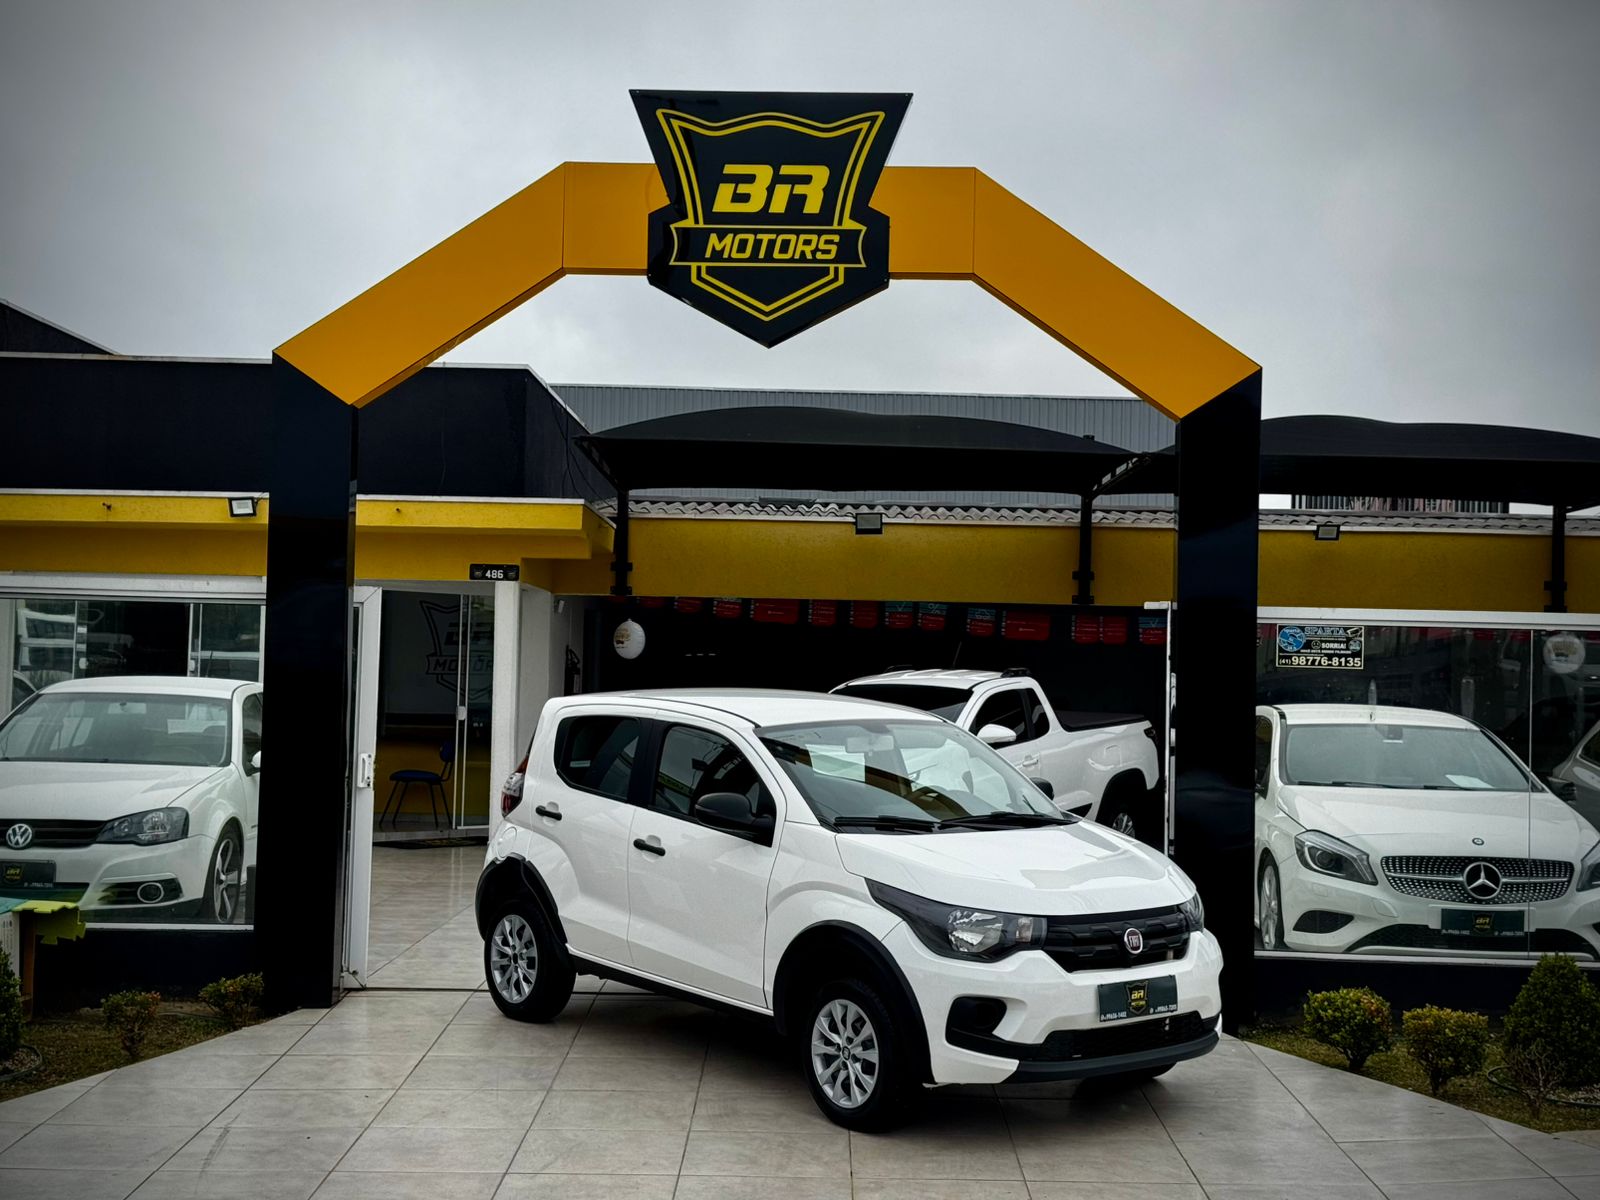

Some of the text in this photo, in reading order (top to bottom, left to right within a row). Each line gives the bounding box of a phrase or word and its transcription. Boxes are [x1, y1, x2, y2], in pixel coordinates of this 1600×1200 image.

[712, 164, 830, 214] BR
[705, 233, 840, 260] MOTORS
[485, 570, 504, 579] 486
[1304, 626, 1346, 635] SPARTA
[1291, 656, 1361, 667] 98776-8135
